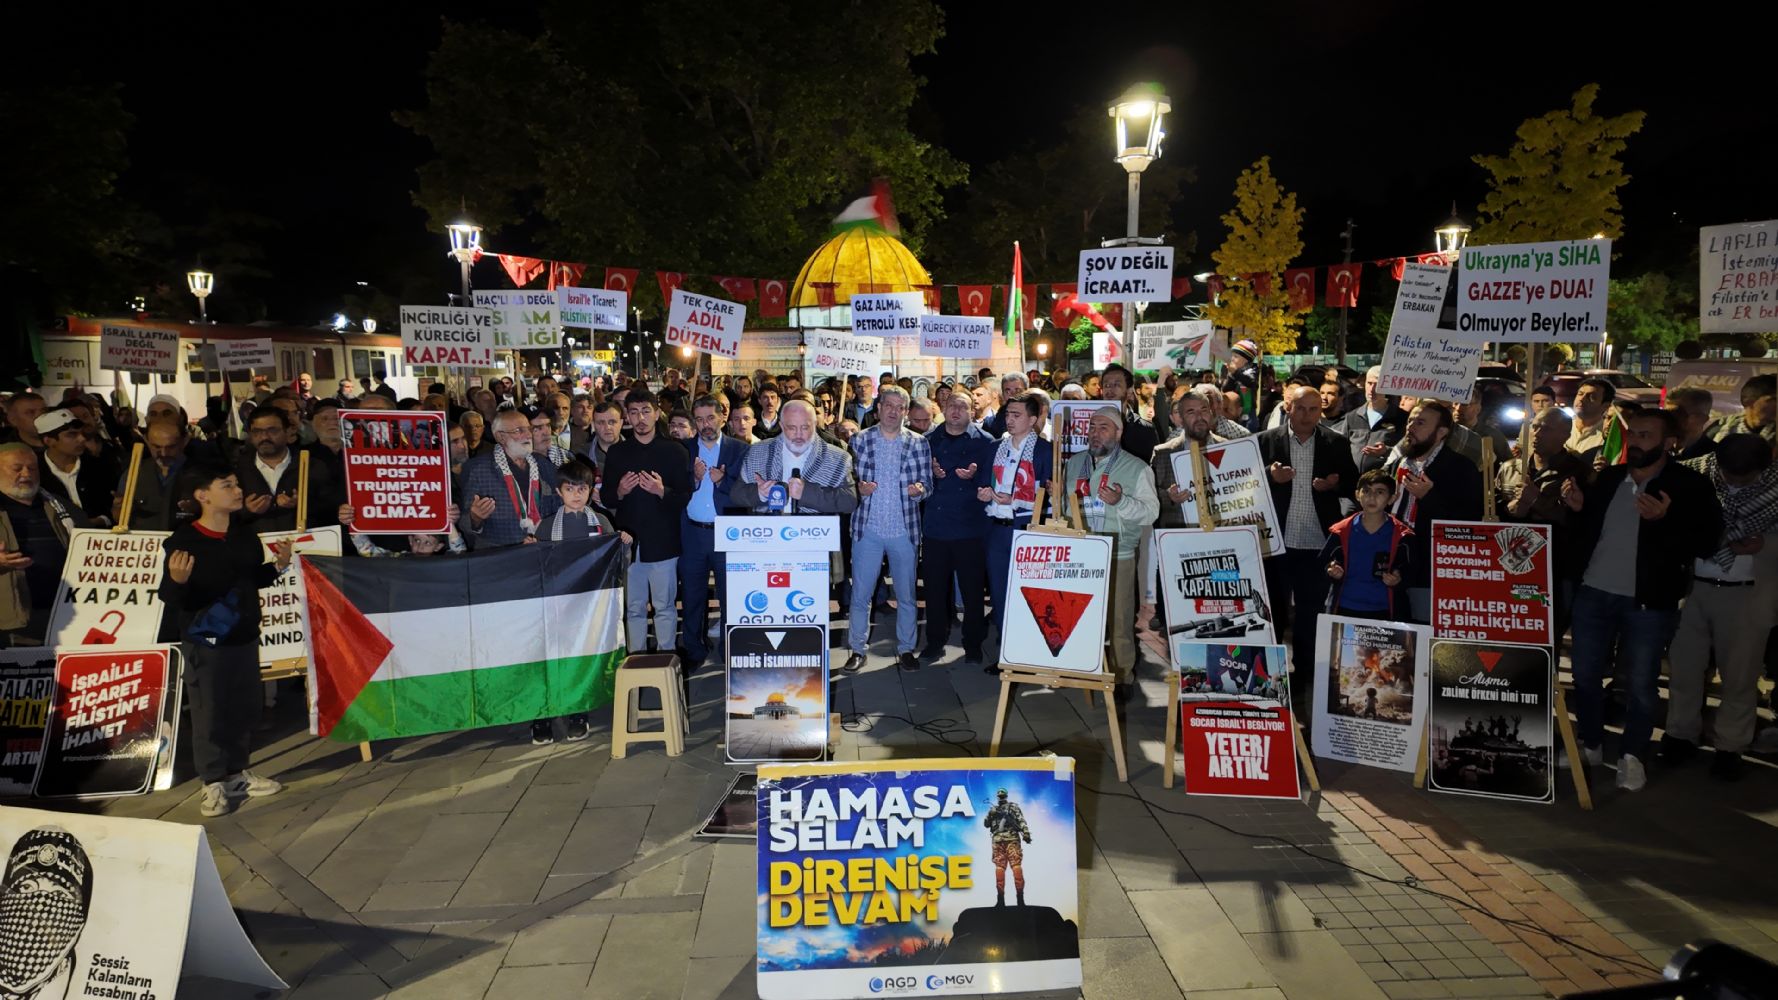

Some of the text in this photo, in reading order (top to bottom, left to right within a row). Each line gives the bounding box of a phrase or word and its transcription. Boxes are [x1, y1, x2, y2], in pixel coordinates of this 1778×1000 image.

[1709, 231, 1768, 253] LAFLA
[1086, 251, 1169, 276] ŞOV DEĞİL
[1465, 240, 1601, 274] Ukrayna'ya SİHA
[1084, 277, 1155, 295] İCRAAT!..
[1468, 277, 1594, 304] GAZZE'ye DUA!
[527, 293, 555, 305] DEĞİL
[682, 295, 734, 316] TEK ÇARE
[855, 300, 873, 311] GAZ
[1402, 301, 1435, 313] ERBAKAN
[402, 309, 491, 327] İNCİRLİĞİ VE
[687, 309, 725, 332] ADİL
[856, 315, 895, 331] PETROLÜ
[1460, 312, 1526, 337] Olmuyor
[103, 326, 177, 342] İSRAİL LAFTAN
[414, 327, 481, 343] KÜRECİĞİ
[668, 323, 738, 356] DÜZEN..!
[125, 338, 155, 349] DEĞİL
[948, 337, 966, 349] KÖR
[968, 339, 980, 350] ET!
[122, 358, 157, 367] ANLAR
[405, 346, 491, 365] KAPAT..!
[840, 357, 855, 370] DEF
[350, 454, 441, 466] DOMUZDAN
[376, 468, 418, 478] POST
[1189, 467, 1252, 489] ASA TUFANI
[353, 481, 441, 492] TRUMPTAN
[1223, 479, 1261, 495] EDİYOR
[373, 492, 425, 505] DOST
[1207, 496, 1254, 516] İRENEN
[362, 506, 437, 519] OLMAZ.
[741, 527, 773, 538] AGD
[800, 527, 831, 537] MGV
[86, 537, 160, 552] İNCİRLİĞİ
[1437, 542, 1476, 556] İŞGALİ
[83, 553, 157, 569] KÜRECİĞİ
[1016, 546, 1072, 563] GAZZE'DE
[1436, 557, 1491, 567] SOYKIRIMI
[77, 571, 156, 584] VANALARI
[1054, 569, 1079, 579] DEVAM
[1080, 569, 1105, 579] EDİYOR
[1436, 568, 1505, 582] BESLEME!
[1180, 578, 1251, 597] KAPATILSIN
[64, 587, 160, 606] KAPAT
[1438, 597, 1529, 614] KATİLLER ve
[740, 614, 817, 624] AGD MGV
[1438, 611, 1545, 632] İŞ BİRLİKÇİLER
[258, 630, 305, 647] NIND
[730, 652, 821, 668] KUDÜS İSLAMINDIR!
[1219, 657, 1248, 671] SOCAR
[71, 659, 144, 692] İSRAİLLE
[1458, 671, 1511, 687] Alışma
[69, 678, 142, 711] TİCARET
[1441, 686, 1538, 705] ZALİME ÖFKENİ DİRİ TUT!
[65, 694, 150, 731] FİLİSTİN'E
[1190, 717, 1216, 728] SOCAR
[1247, 719, 1286, 732] BESLİYOR!
[62, 719, 127, 751] İHANET
[769, 785, 976, 823] HAMASA
[769, 816, 925, 853] SELAM
[769, 854, 974, 900] DİRENİŞE
[769, 890, 940, 928] DEVAM
[91, 953, 130, 971] Sessiz
[87, 968, 153, 989] Kalanların
[885, 976, 917, 988] AGD
[945, 974, 975, 985] MGV
[84, 982, 156, 1000] hesabını da
